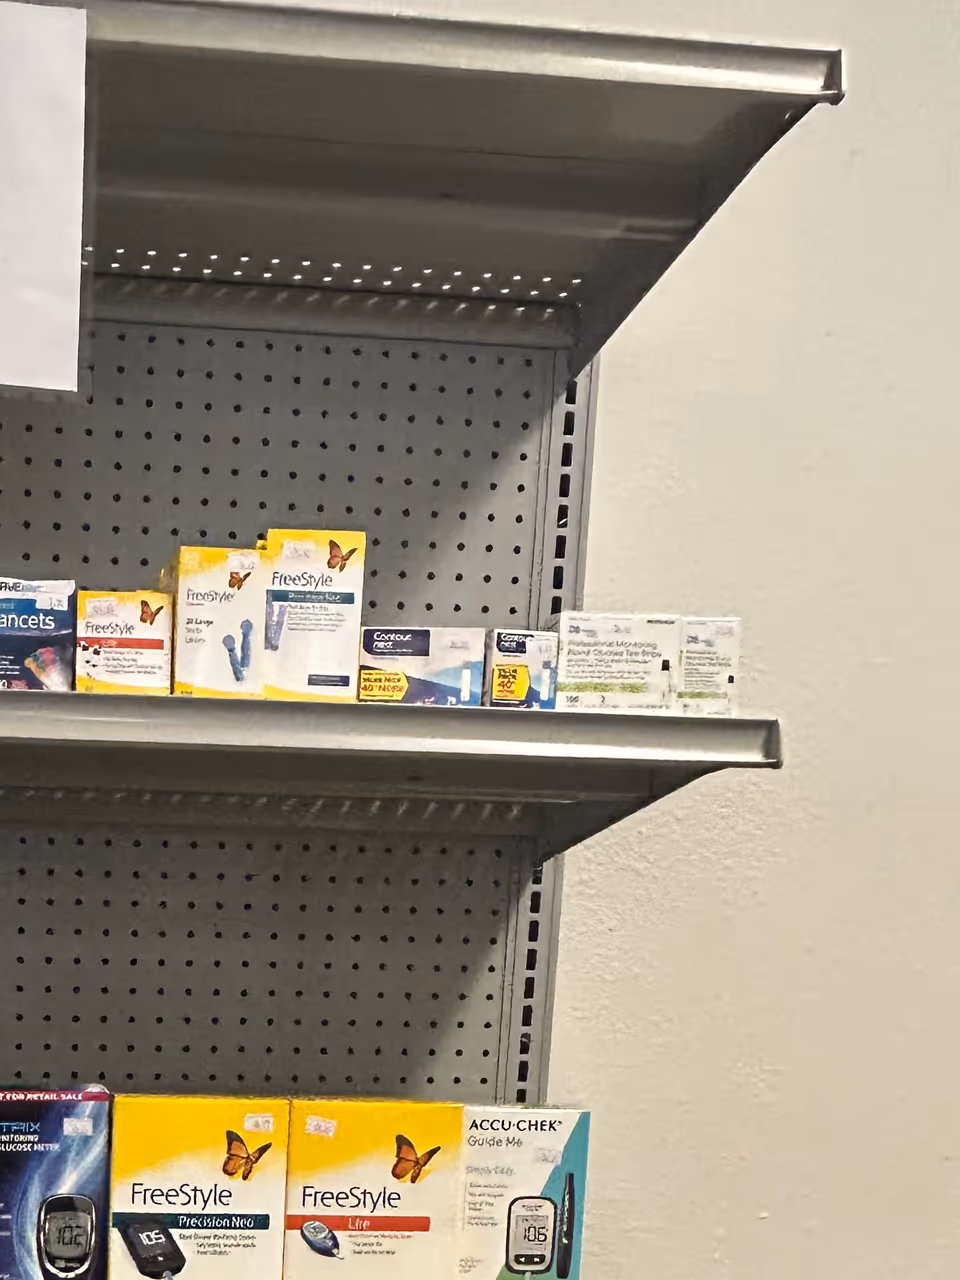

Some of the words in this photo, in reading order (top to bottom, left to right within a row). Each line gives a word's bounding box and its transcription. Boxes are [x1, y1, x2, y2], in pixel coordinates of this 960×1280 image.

[272, 571, 333, 590] FreeStyle
[186, 588, 236, 604] FreeStyle
[85, 620, 135, 638] FreeStyle
[467, 1135, 503, 1148] Guide
[131, 1183, 233, 1211] FreeStyle
[302, 1185, 402, 1214] FreeStyle
[178, 1214, 231, 1228] Precision
[231, 1215, 254, 1228] Neo
